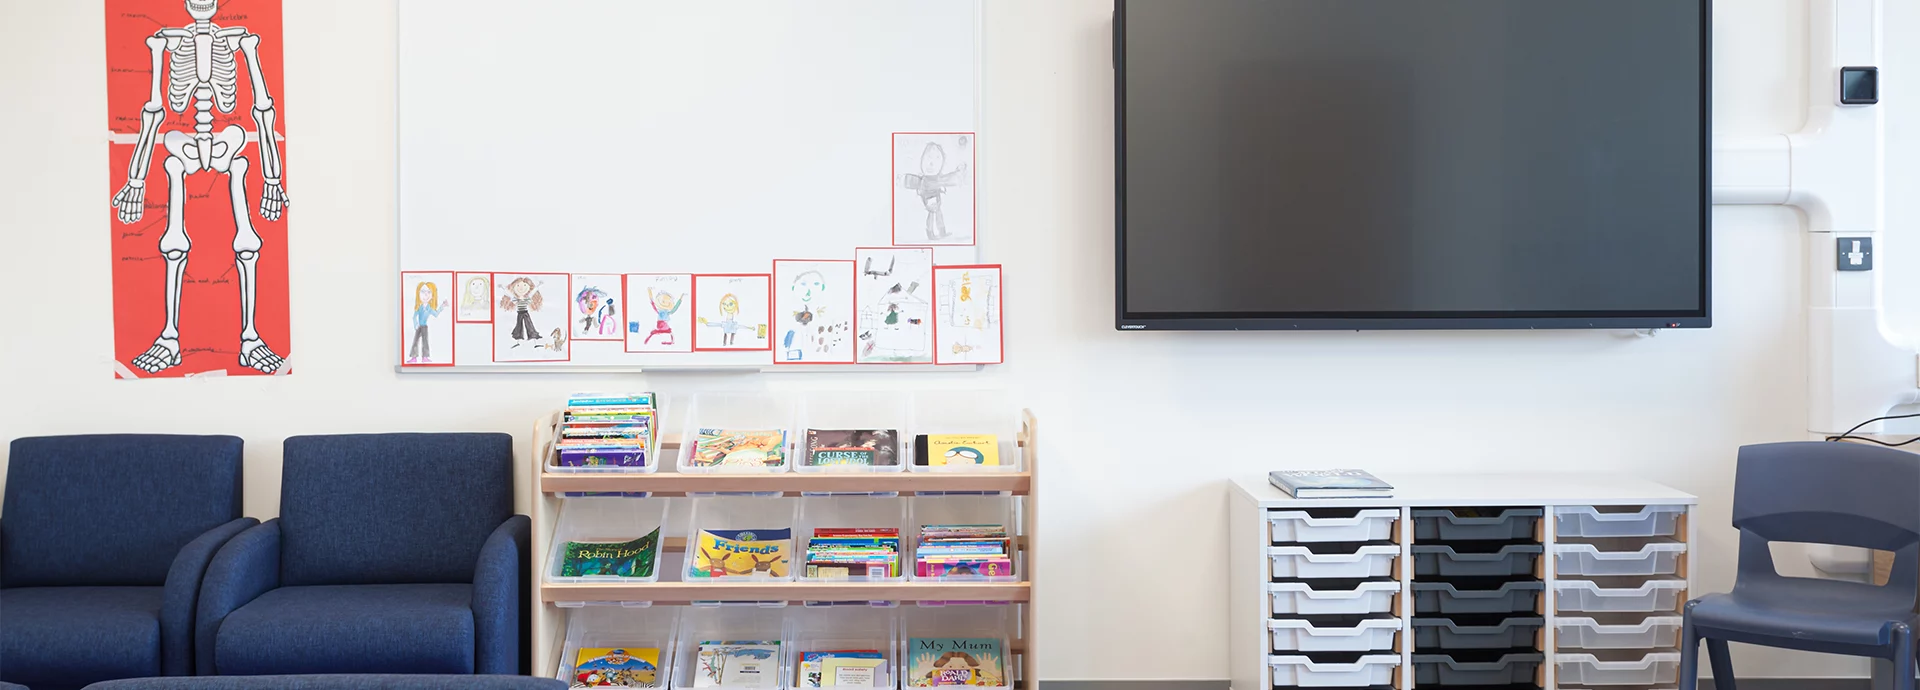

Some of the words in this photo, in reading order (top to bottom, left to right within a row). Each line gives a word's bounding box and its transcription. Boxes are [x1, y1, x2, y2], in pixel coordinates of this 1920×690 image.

[578, 549, 613, 559] Robin
[616, 541, 650, 558] Hood
[712, 537, 779, 555] Friends
[919, 639, 944, 652] My
[952, 639, 992, 650] Mum
[939, 669, 969, 677] ROALD
[941, 674, 966, 682] DAHL
